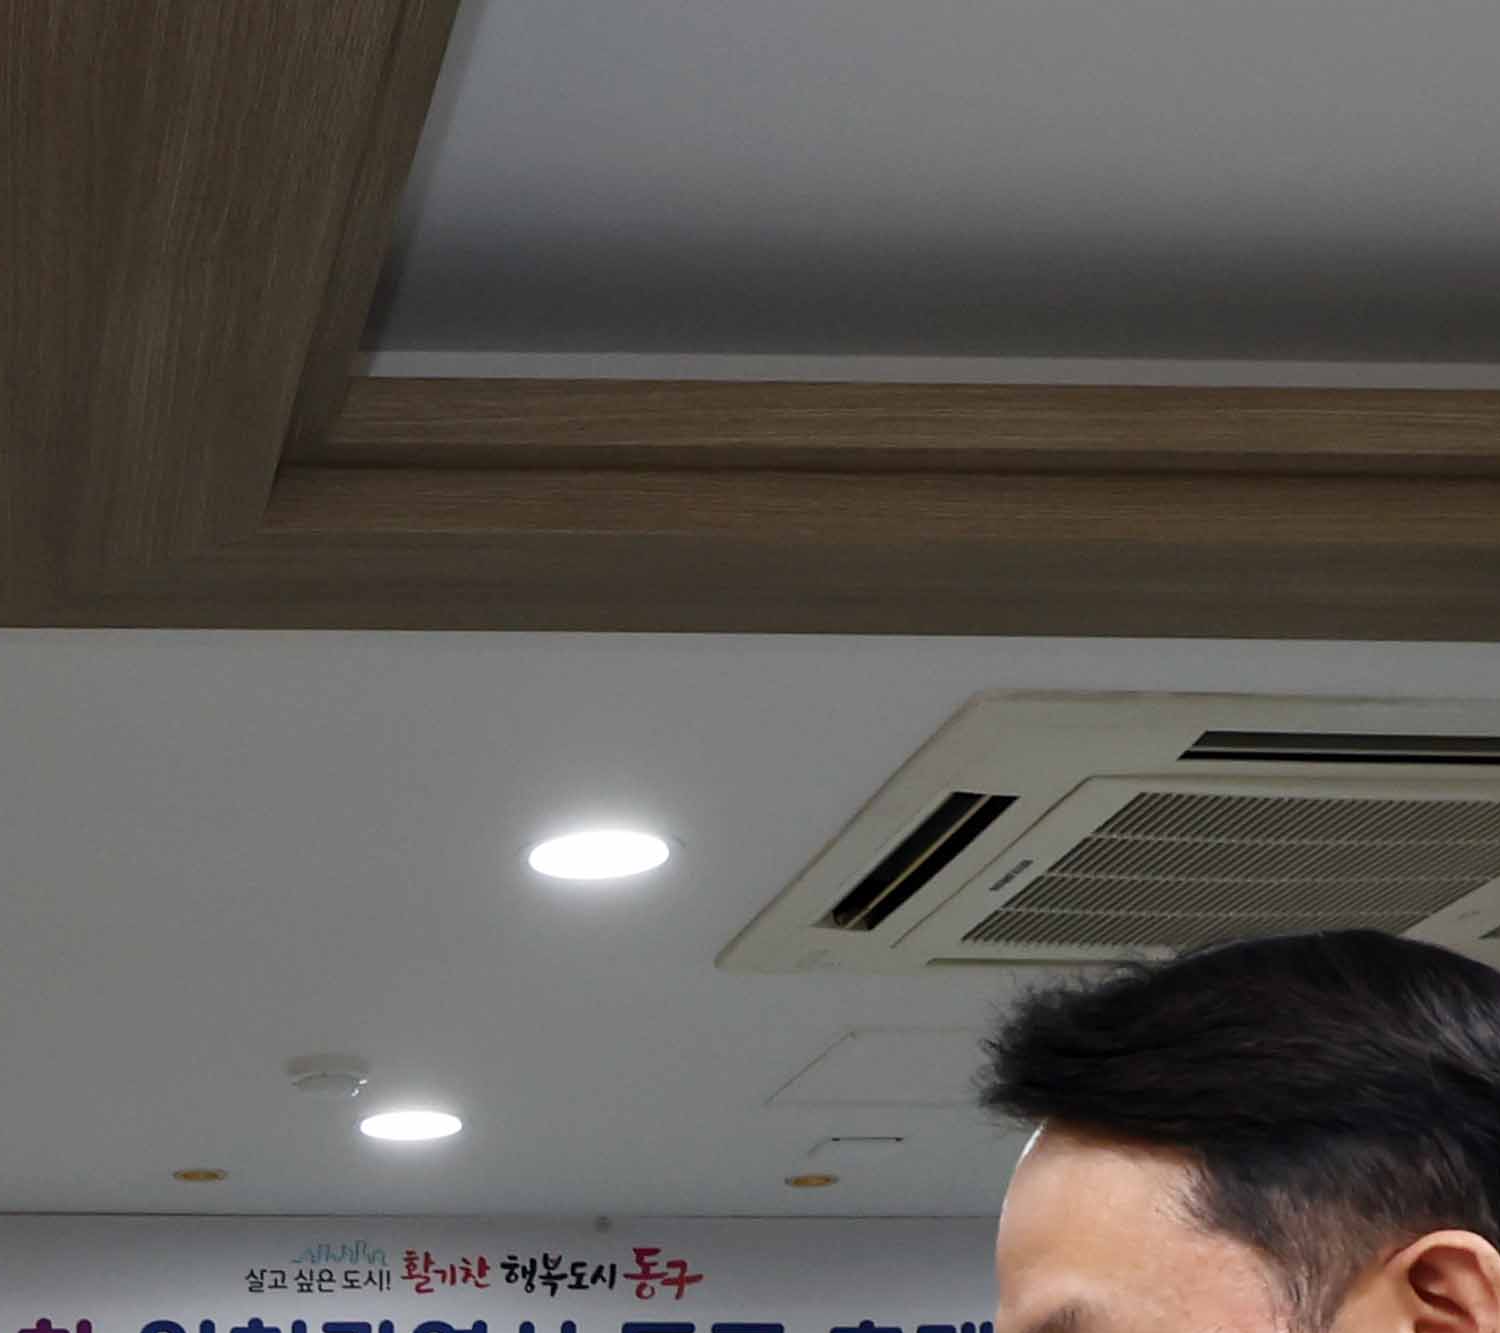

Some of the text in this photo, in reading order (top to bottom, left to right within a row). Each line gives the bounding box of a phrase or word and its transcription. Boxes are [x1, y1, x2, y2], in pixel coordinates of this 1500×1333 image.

[245, 1248, 703, 1300] 살고 싶은 도시! 활기찬 행복도시 동구
